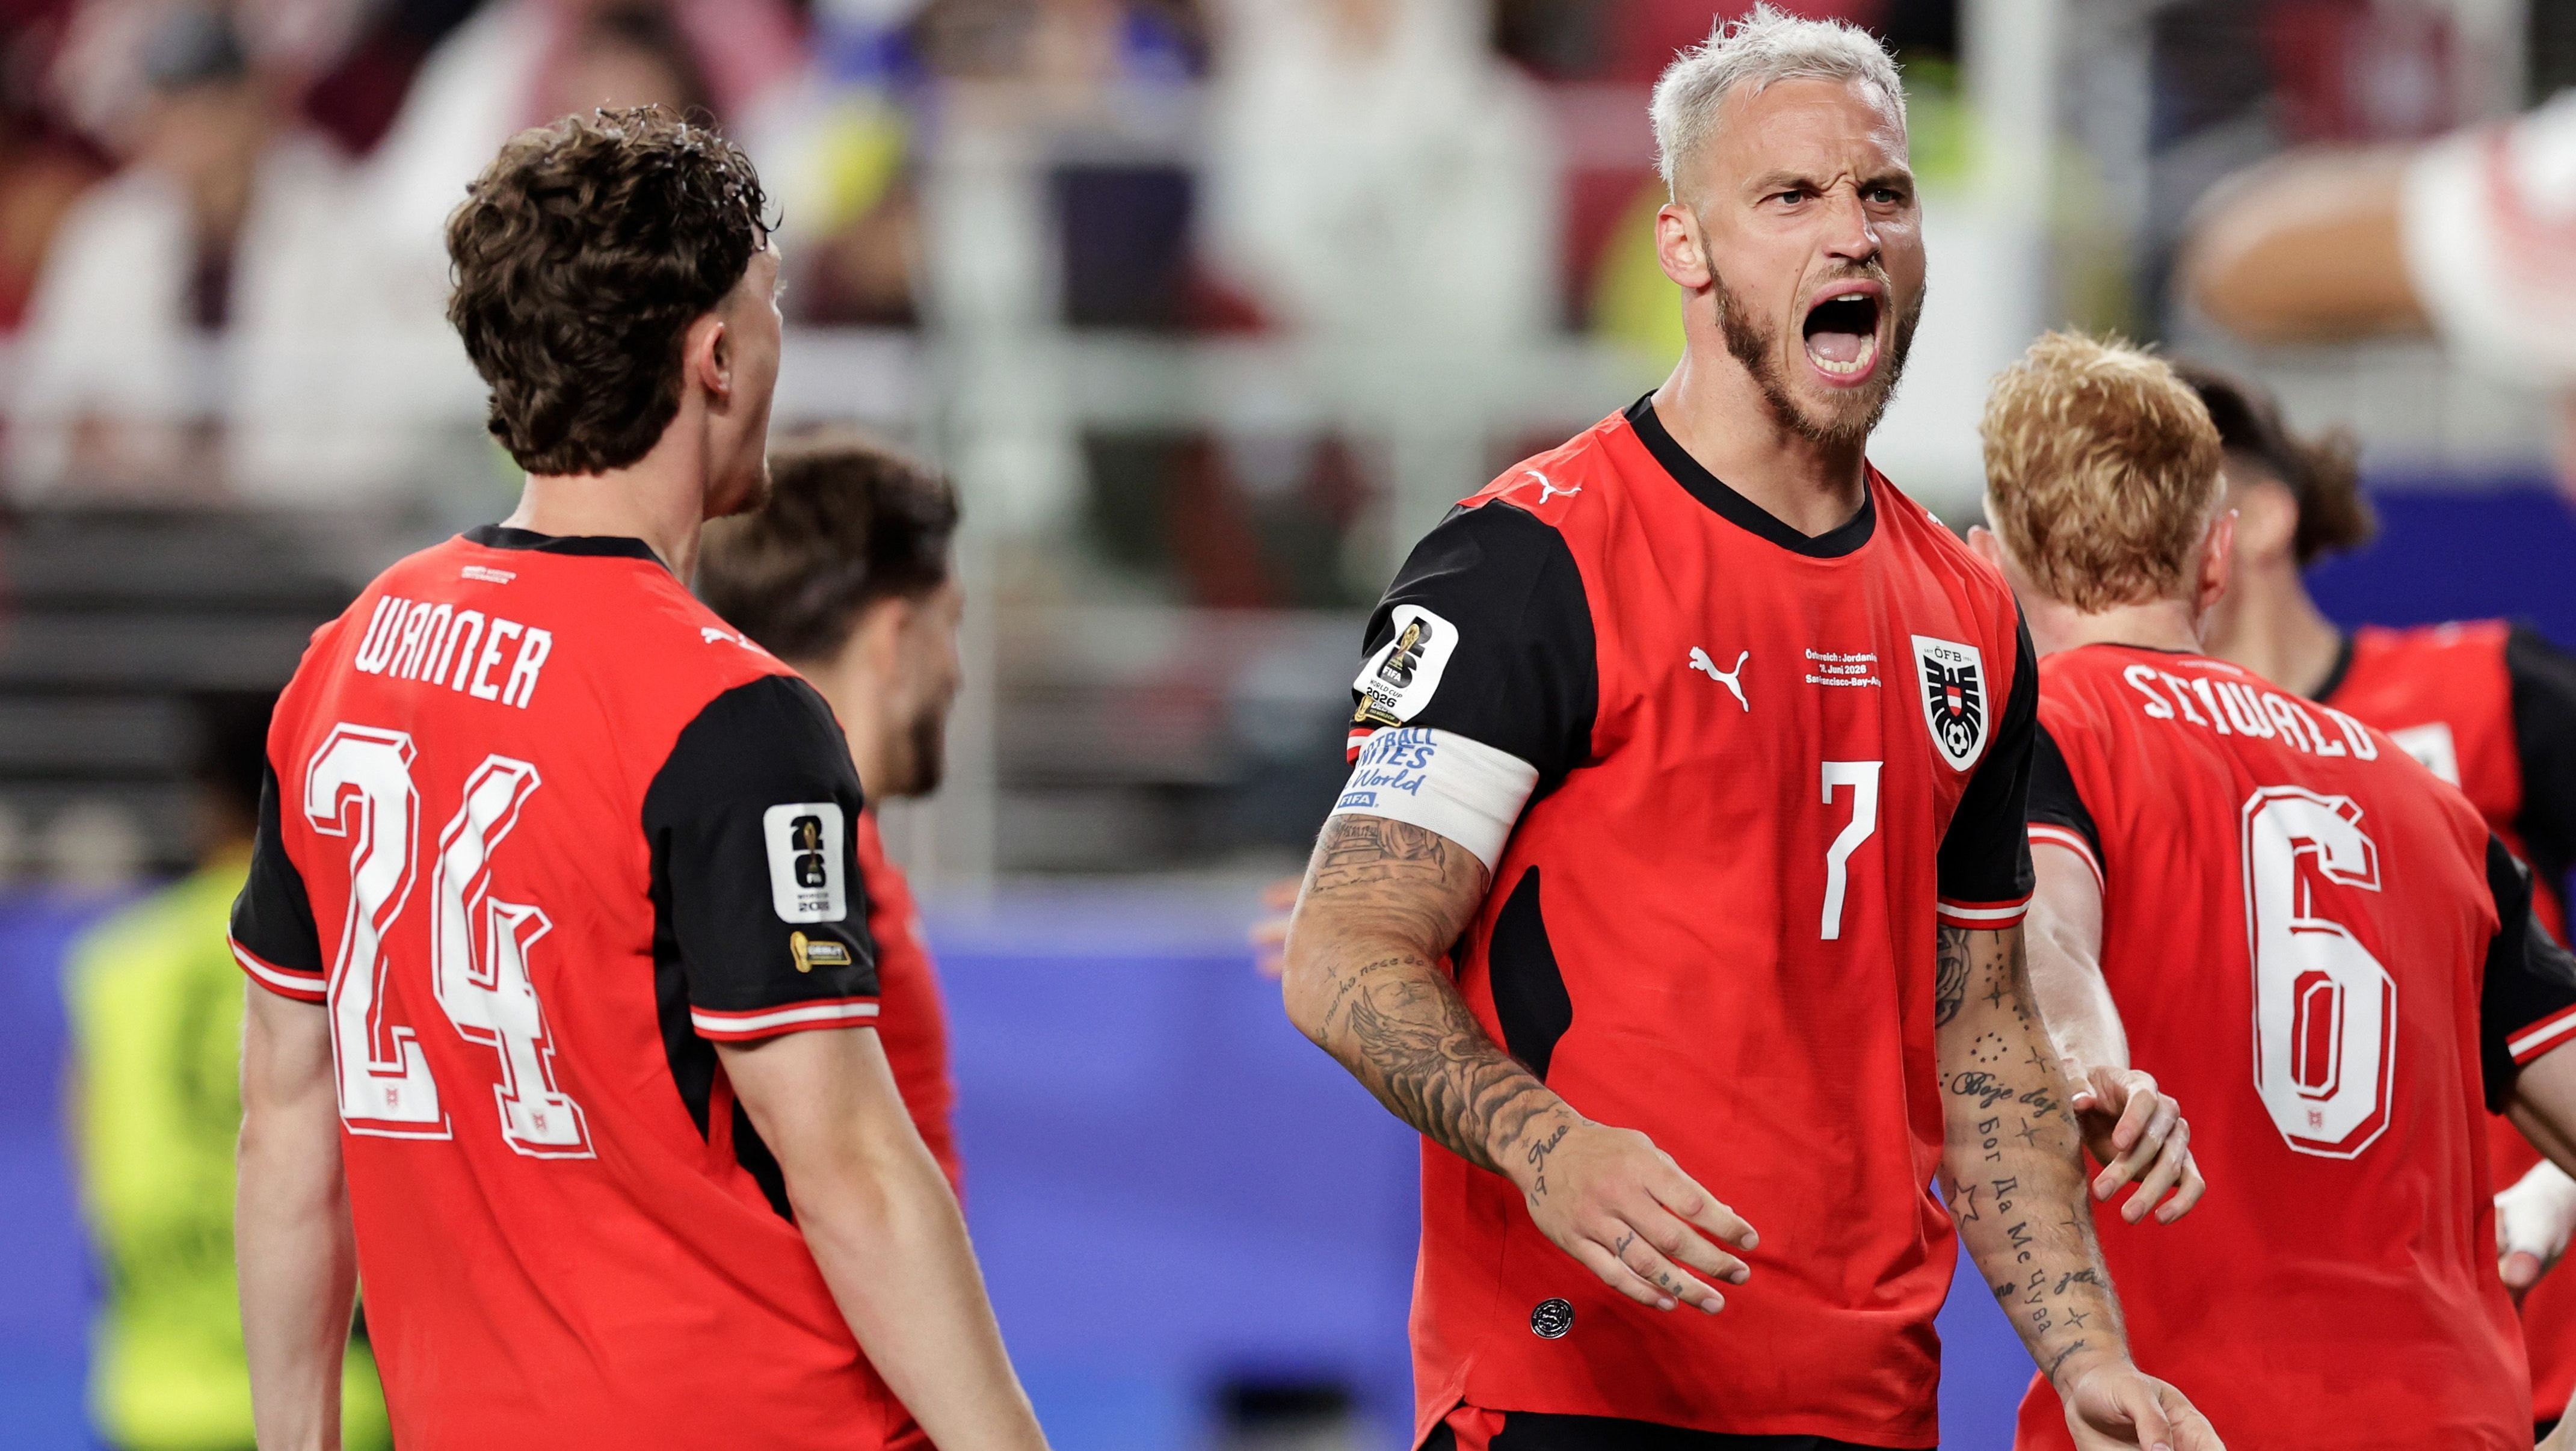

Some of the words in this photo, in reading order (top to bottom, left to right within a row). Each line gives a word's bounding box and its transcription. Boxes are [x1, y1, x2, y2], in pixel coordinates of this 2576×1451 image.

[354, 595, 553, 709] WANNER
[1934, 645, 1962, 662] ÖFB
[1382, 666, 1402, 682] FIFA
[1828, 665, 1844, 675] Juni
[1844, 664, 1867, 674] 2026
[1366, 686, 1397, 708] 2026
[1370, 678, 1390, 692] WORLD
[1388, 689, 1404, 699] CUP
[1356, 746, 1435, 769] NITES
[1352, 768, 1426, 796] World
[1339, 793, 1372, 806] FIFA
[1821, 761, 1884, 940] 7
[304, 721, 597, 1159] 24
[2242, 785, 2397, 1159] 6
[1979, 1117, 2000, 1162] Бог
[1992, 1175, 2018, 1215] Да
[2007, 1221, 2032, 1264] Ме
